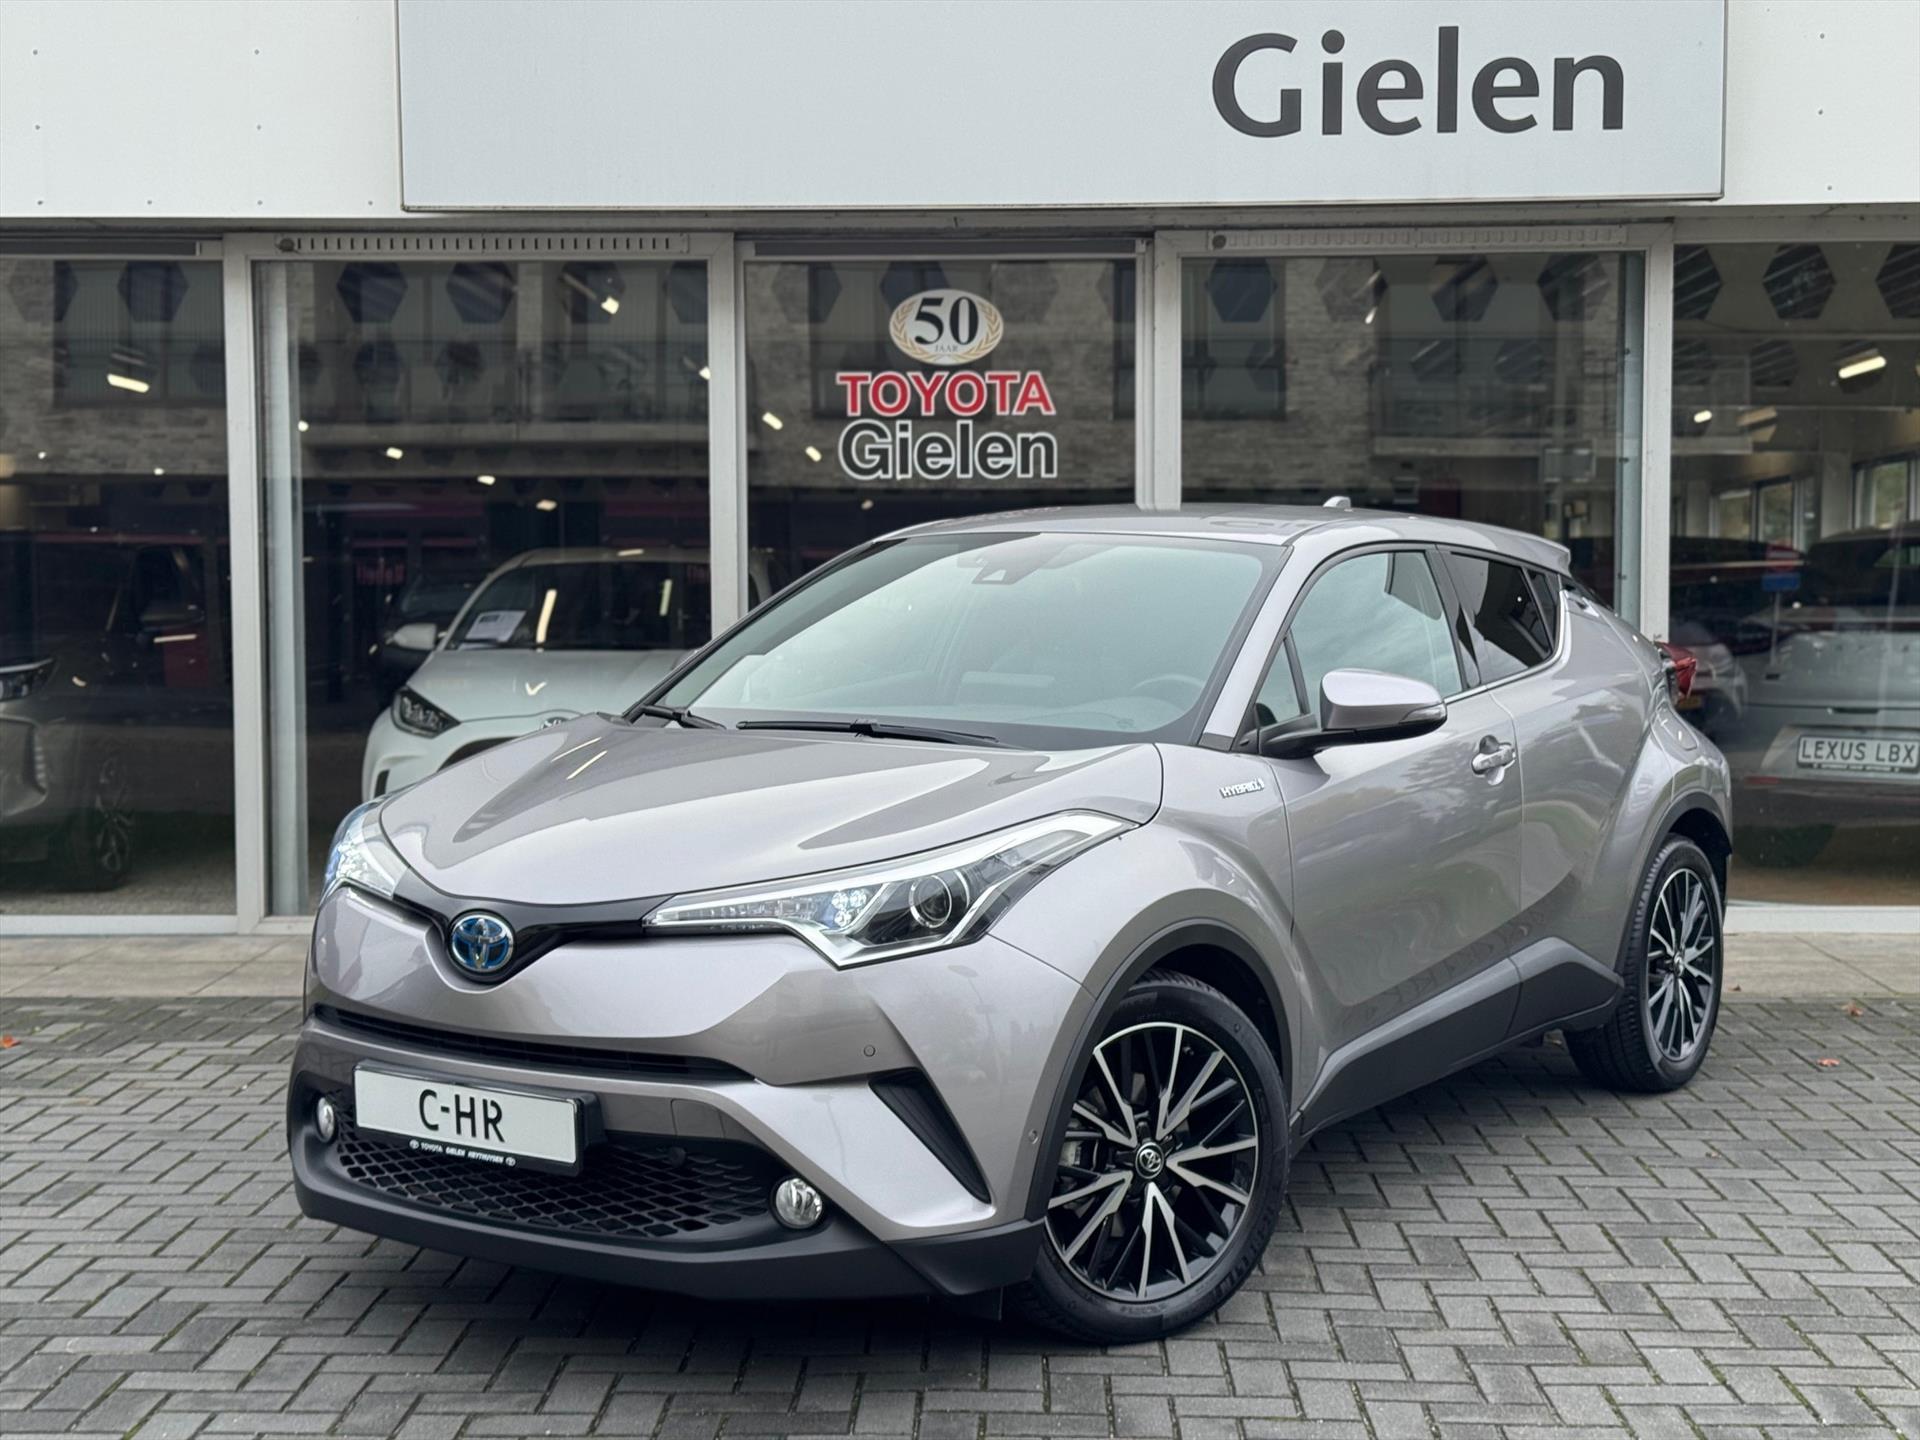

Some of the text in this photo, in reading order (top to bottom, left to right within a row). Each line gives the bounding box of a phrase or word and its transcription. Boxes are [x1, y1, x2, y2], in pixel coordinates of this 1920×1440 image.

[1212, 25, 1625, 138] Gielen
[914, 296, 979, 346] 50
[934, 344, 959, 354] JAAR
[836, 371, 1056, 416] TOYOTA
[838, 418, 1058, 480] Gielen
[1801, 739, 1915, 764] LEXUS LBX
[1219, 779, 1259, 798] HYBRID
[418, 1088, 505, 1143] C-HR
[420, 1141, 443, 1153] TOYOTA
